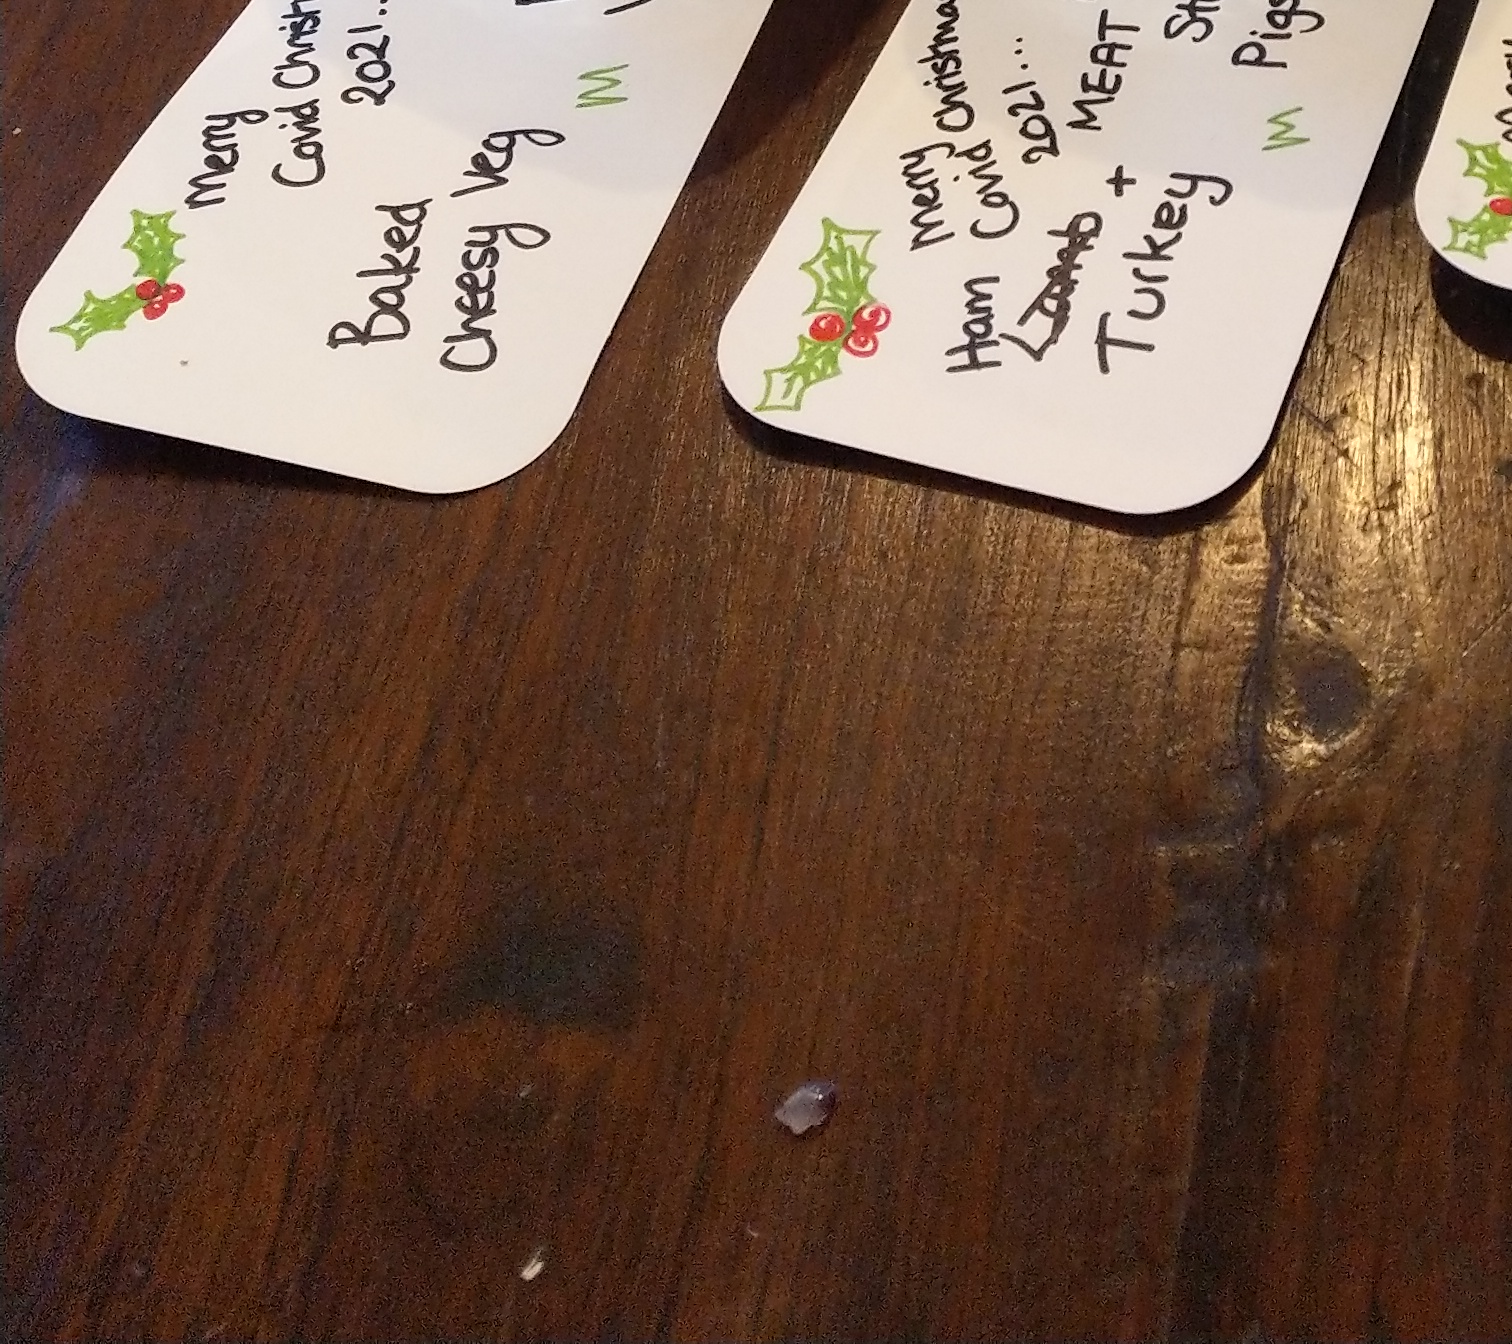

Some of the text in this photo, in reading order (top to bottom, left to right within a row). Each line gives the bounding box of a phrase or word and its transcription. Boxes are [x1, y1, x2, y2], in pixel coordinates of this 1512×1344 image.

[1066, 9, 1140, 131] MEAT
[185, 111, 269, 209] Merry
[272, 101, 325, 186] Covid
[900, 141, 956, 251] Merry
[953, 142, 1020, 239] Covid
[327, 198, 432, 350] Baked
[440, 128, 565, 373] Cheesy Veg
[1096, 171, 1234, 374] Turkey
[945, 276, 1001, 374] Ham
